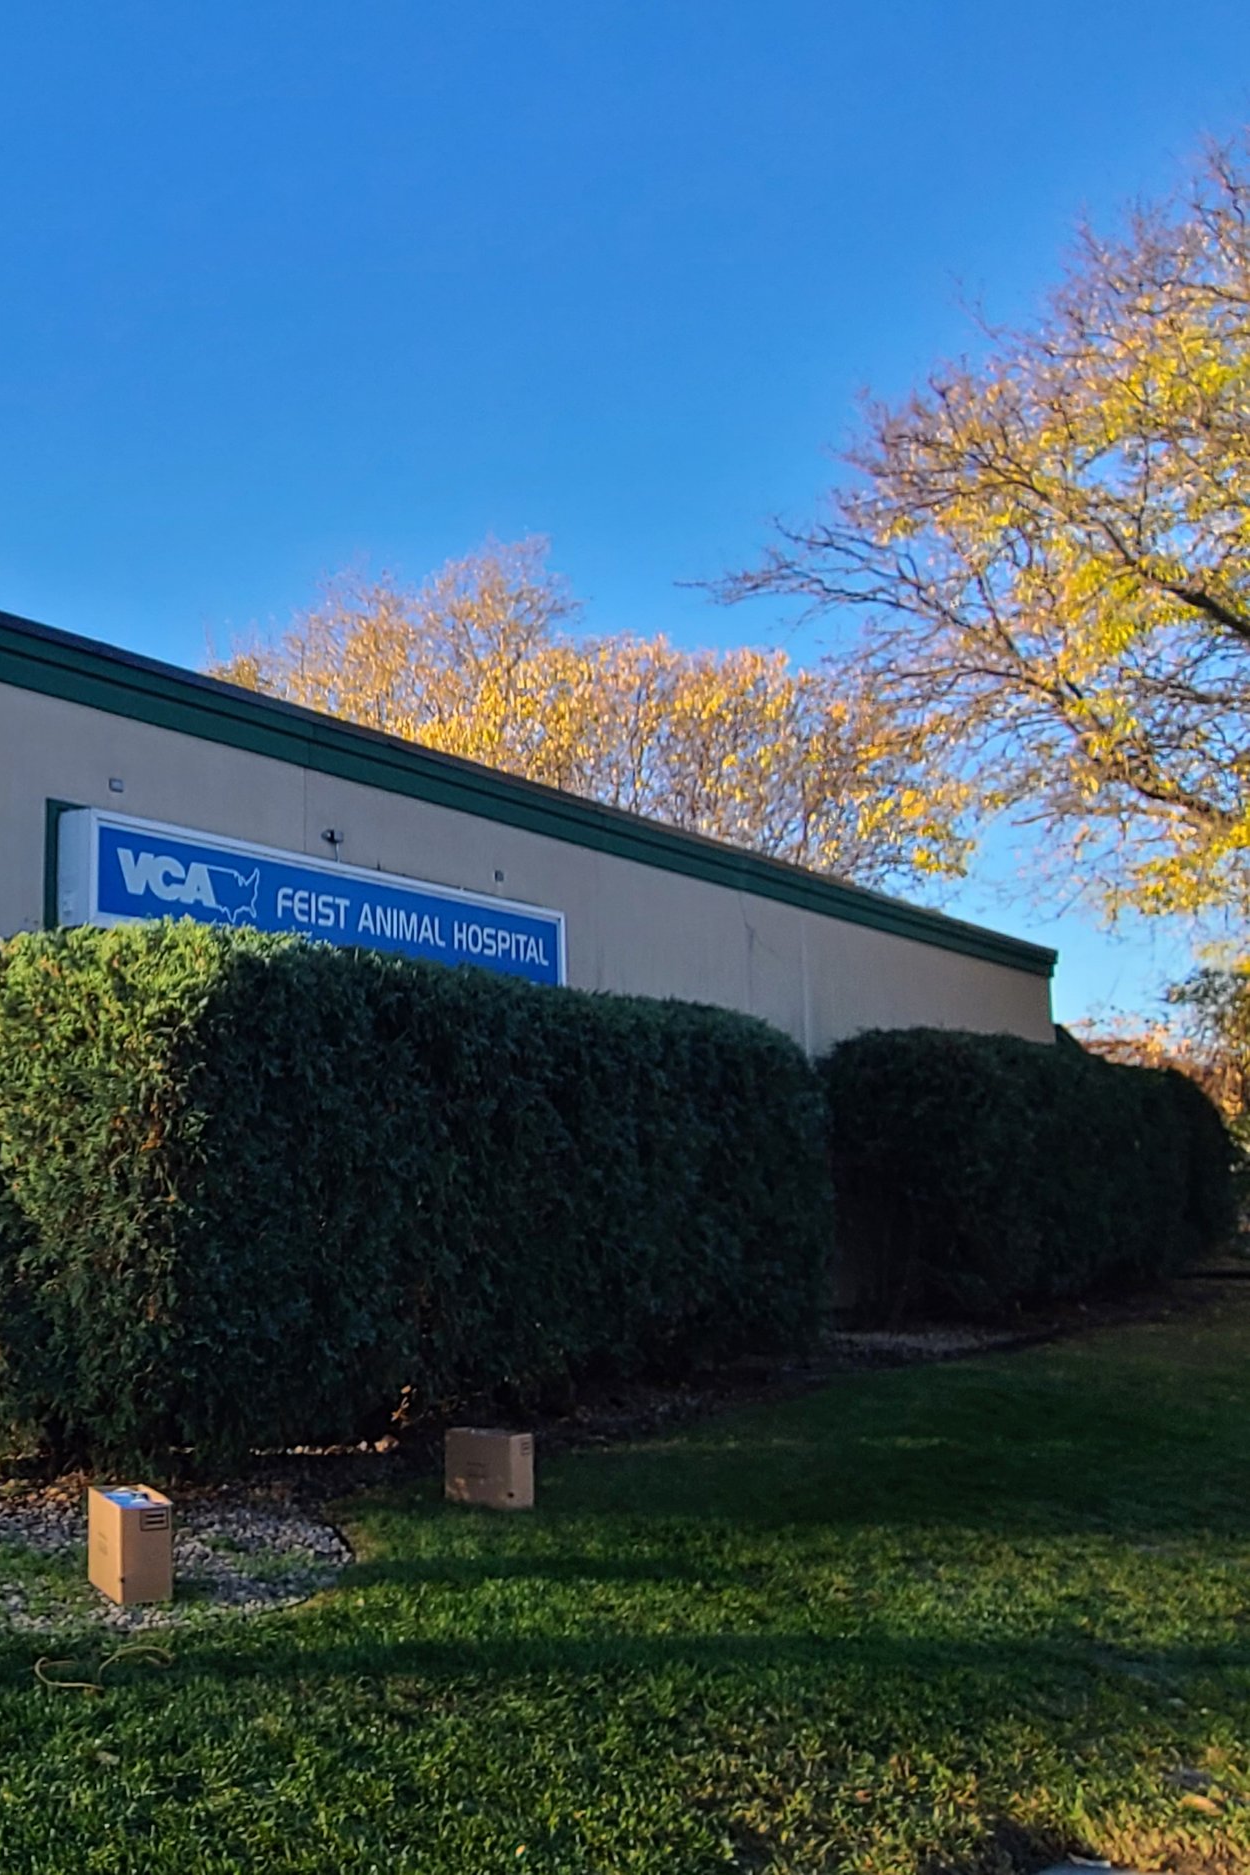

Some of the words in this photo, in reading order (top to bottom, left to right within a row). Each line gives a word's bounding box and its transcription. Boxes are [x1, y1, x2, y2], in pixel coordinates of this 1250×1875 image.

[117, 848, 217, 908] VCA
[277, 886, 350, 929] FEIST
[357, 902, 446, 947] ANIMAL
[454, 920, 549, 966] HOSPITAL
